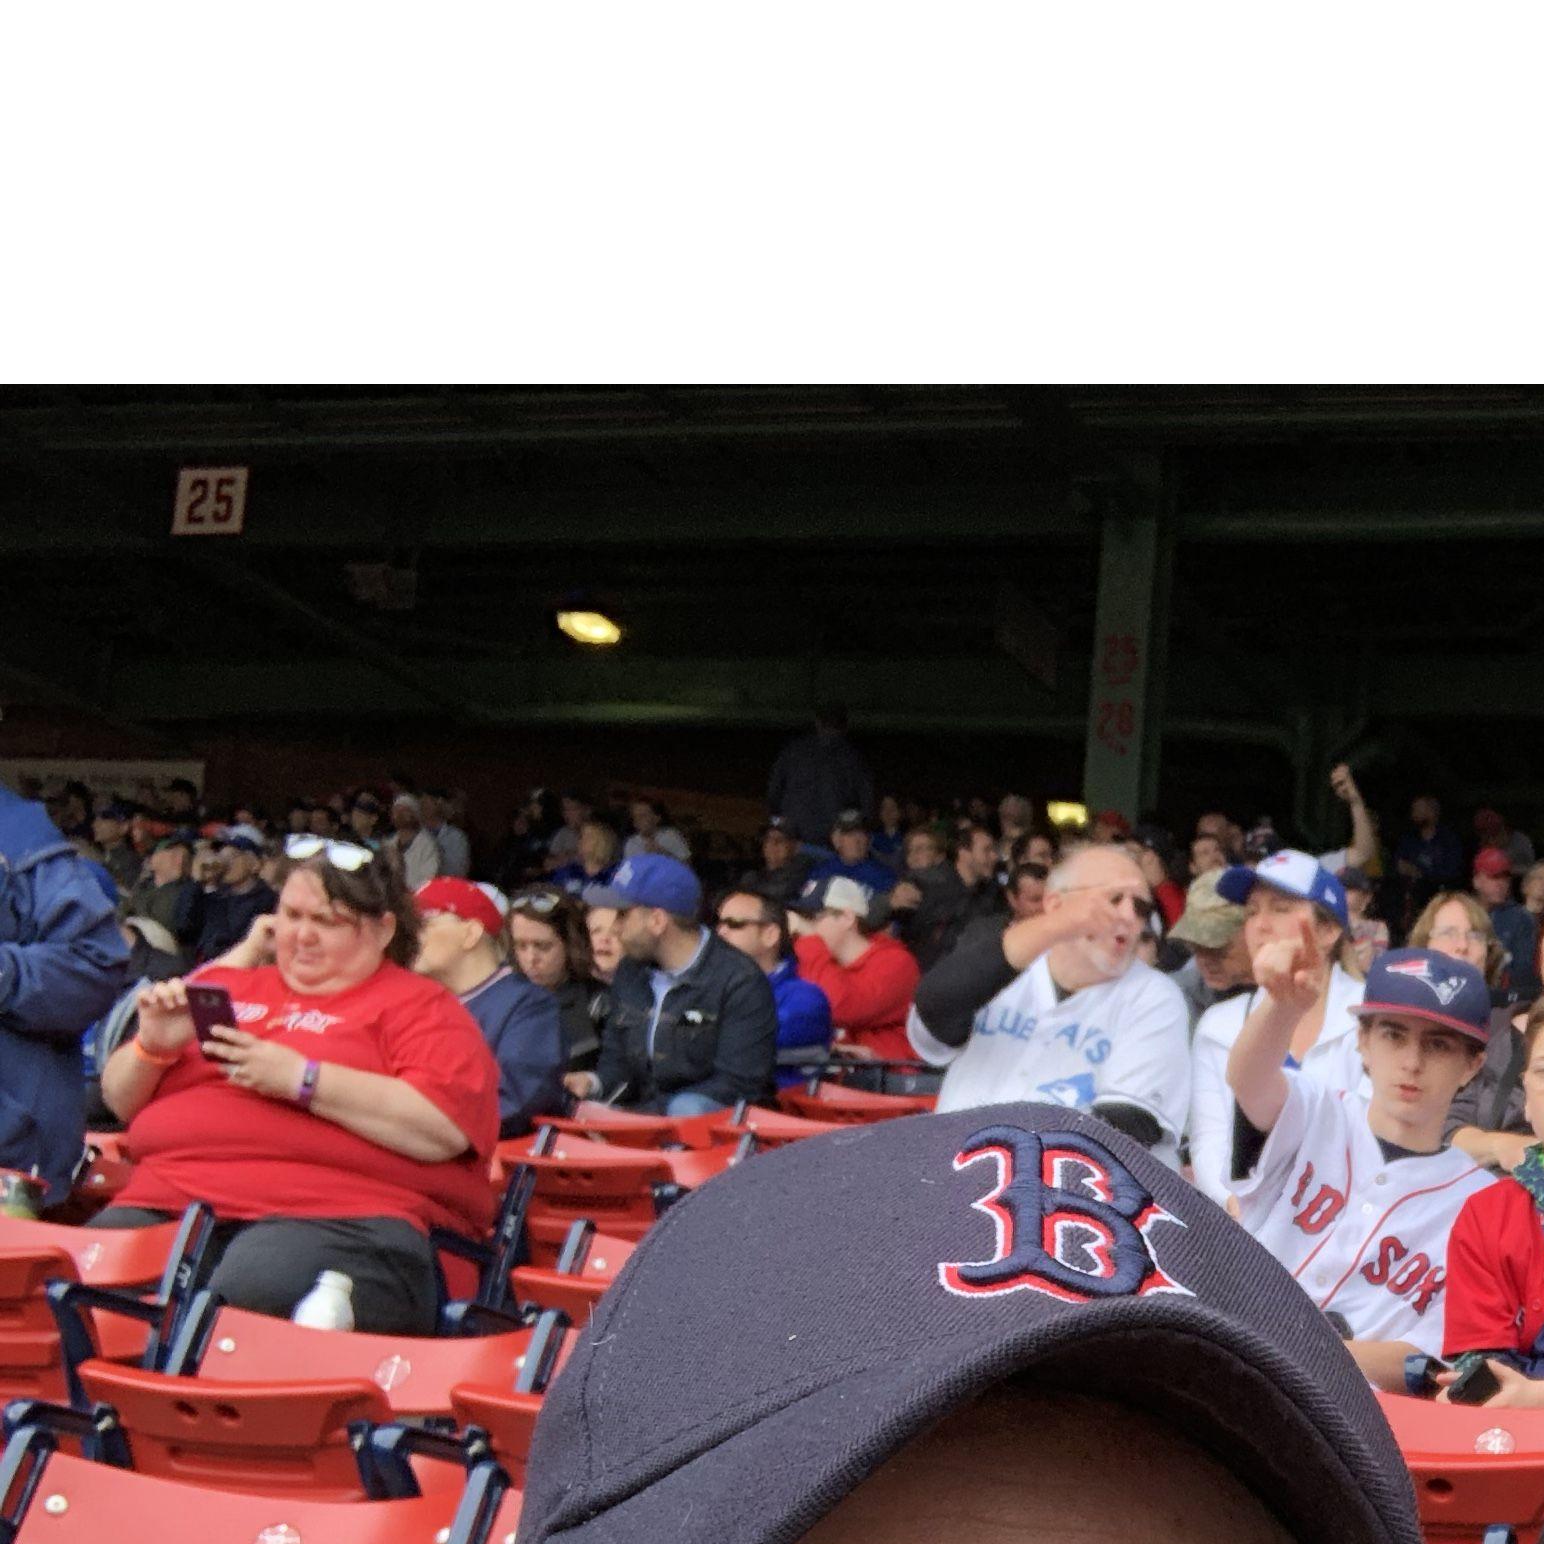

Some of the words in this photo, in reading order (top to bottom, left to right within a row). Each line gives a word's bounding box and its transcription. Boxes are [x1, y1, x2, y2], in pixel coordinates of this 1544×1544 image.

[186, 477, 235, 524] 25
[938, 1124, 1197, 1304] B
[1359, 1235, 1448, 1317] SOX
